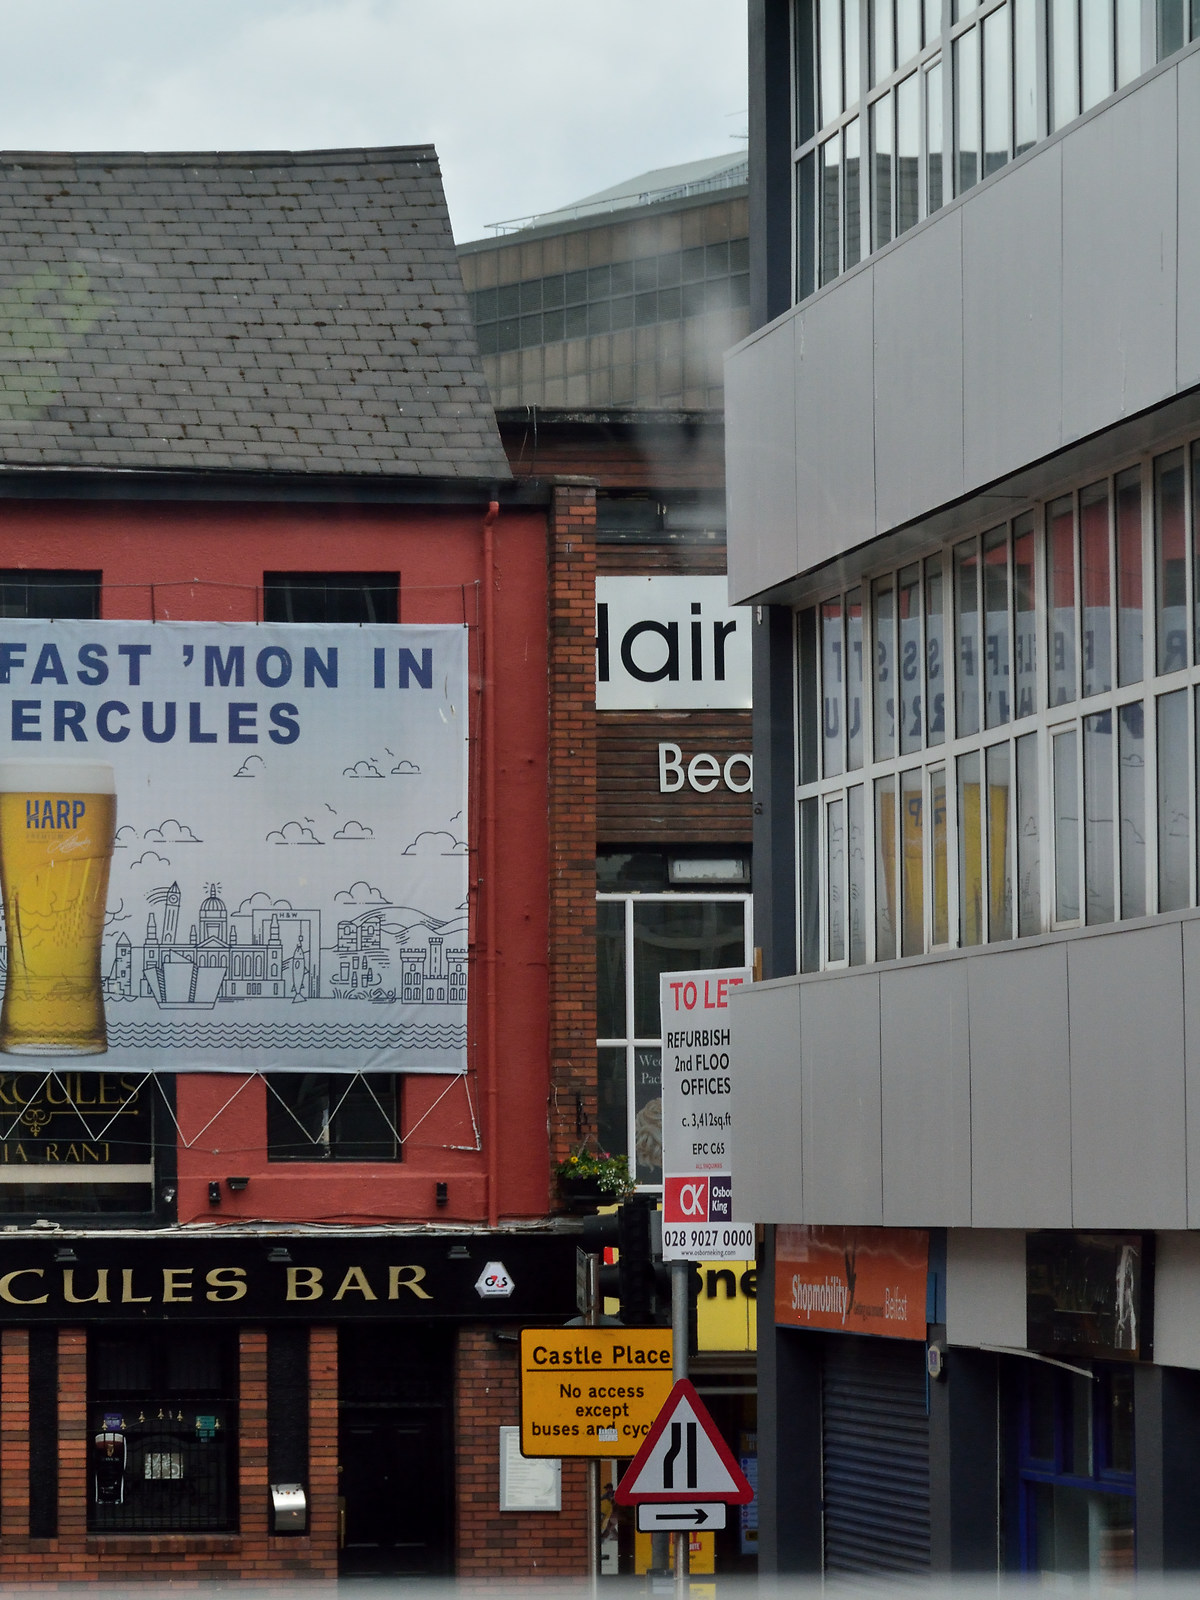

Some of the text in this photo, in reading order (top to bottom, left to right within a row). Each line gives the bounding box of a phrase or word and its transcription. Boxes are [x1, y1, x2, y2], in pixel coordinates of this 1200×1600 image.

[182, 645, 340, 689] 'MON
[373, 647, 435, 690] IN
[26, 800, 85, 829] HARP
[670, 981, 698, 1011] TO
[675, 1055, 692, 1072] 2nd
[680, 1077, 731, 1096] OFFICES
[692, 1142, 725, 1155] EPC C65
[712, 1200, 728, 1214] King
[664, 1230, 753, 1246] 028 9027 0000
[681, 1247, 736, 1258] www.osborneking.com
[286, 1264, 434, 1301] BAR
[697, 1268, 756, 1299] ne
[792, 1274, 848, 1326] Shopmobility
[884, 1286, 908, 1321] Belfast
[532, 1345, 671, 1365] Castle Place
[560, 1384, 644, 1398] No access
[576, 1402, 630, 1419] except
[532, 1422, 580, 1436] buses
